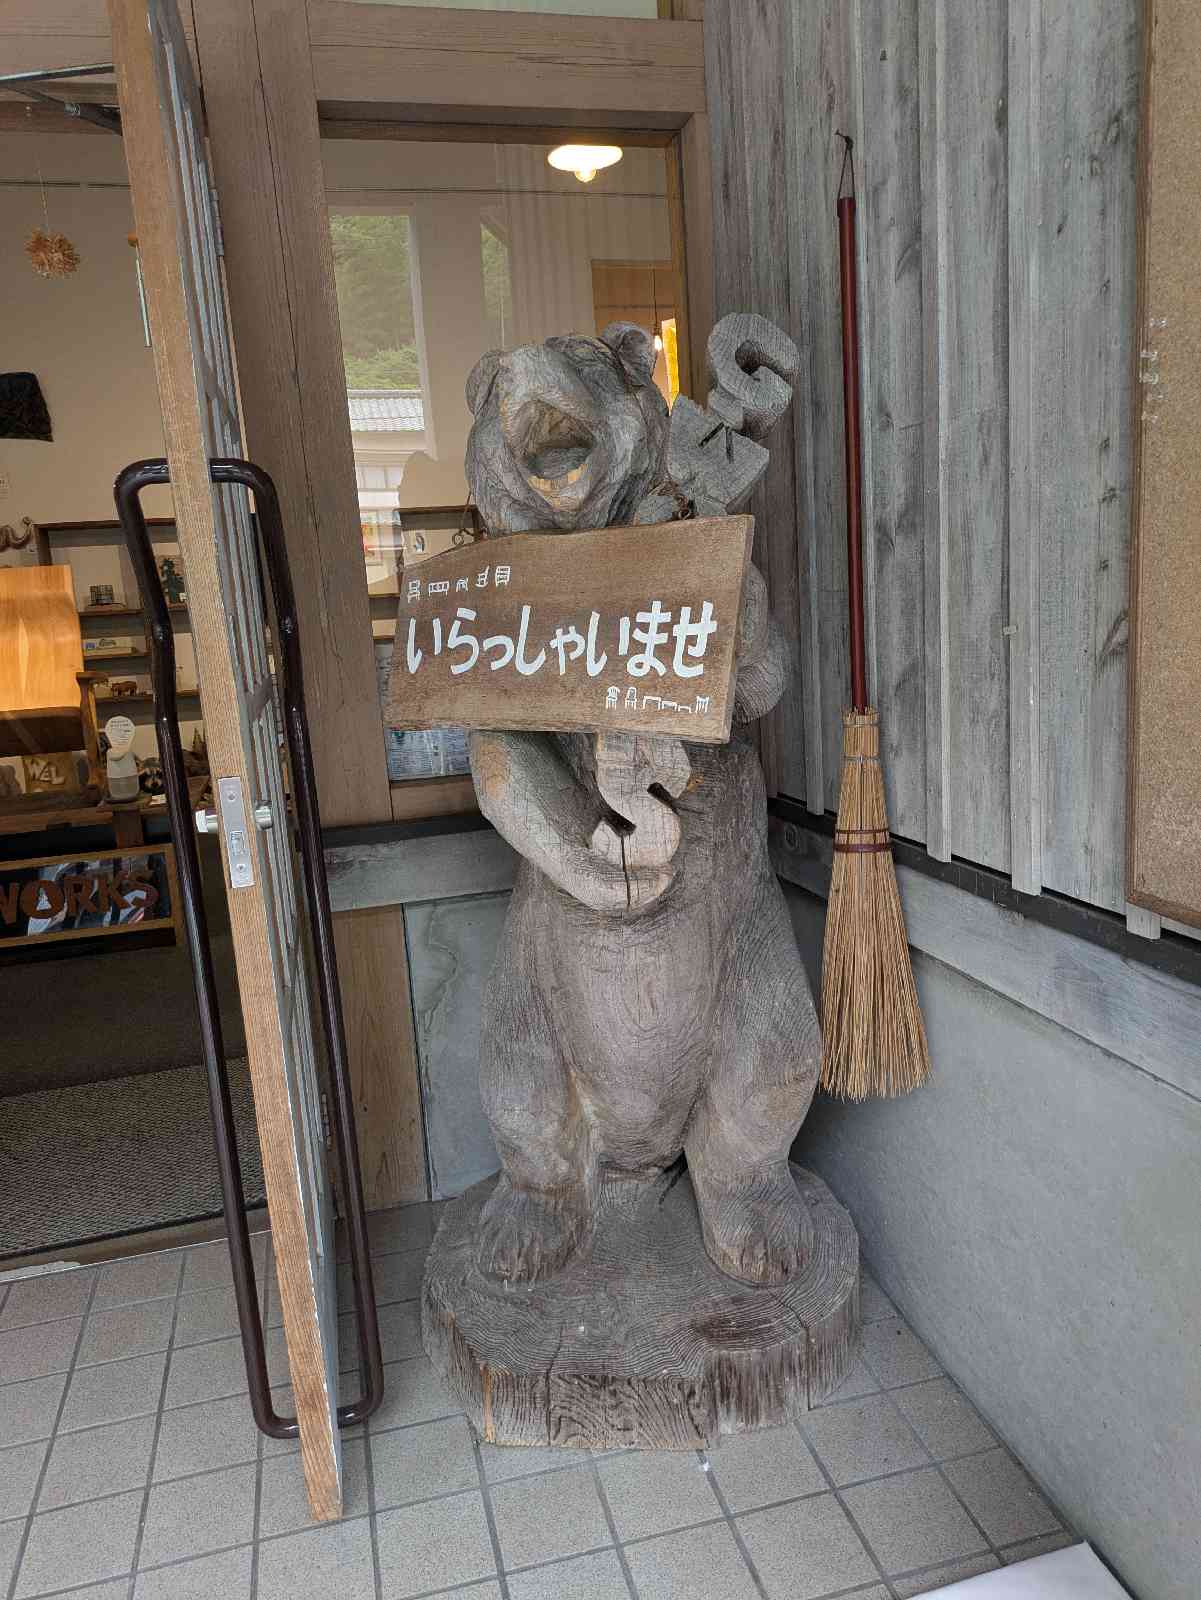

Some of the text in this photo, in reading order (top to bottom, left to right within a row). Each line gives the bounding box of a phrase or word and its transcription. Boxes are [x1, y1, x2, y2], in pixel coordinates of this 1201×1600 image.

[406, 600, 718, 678] いらっしゃいませ
